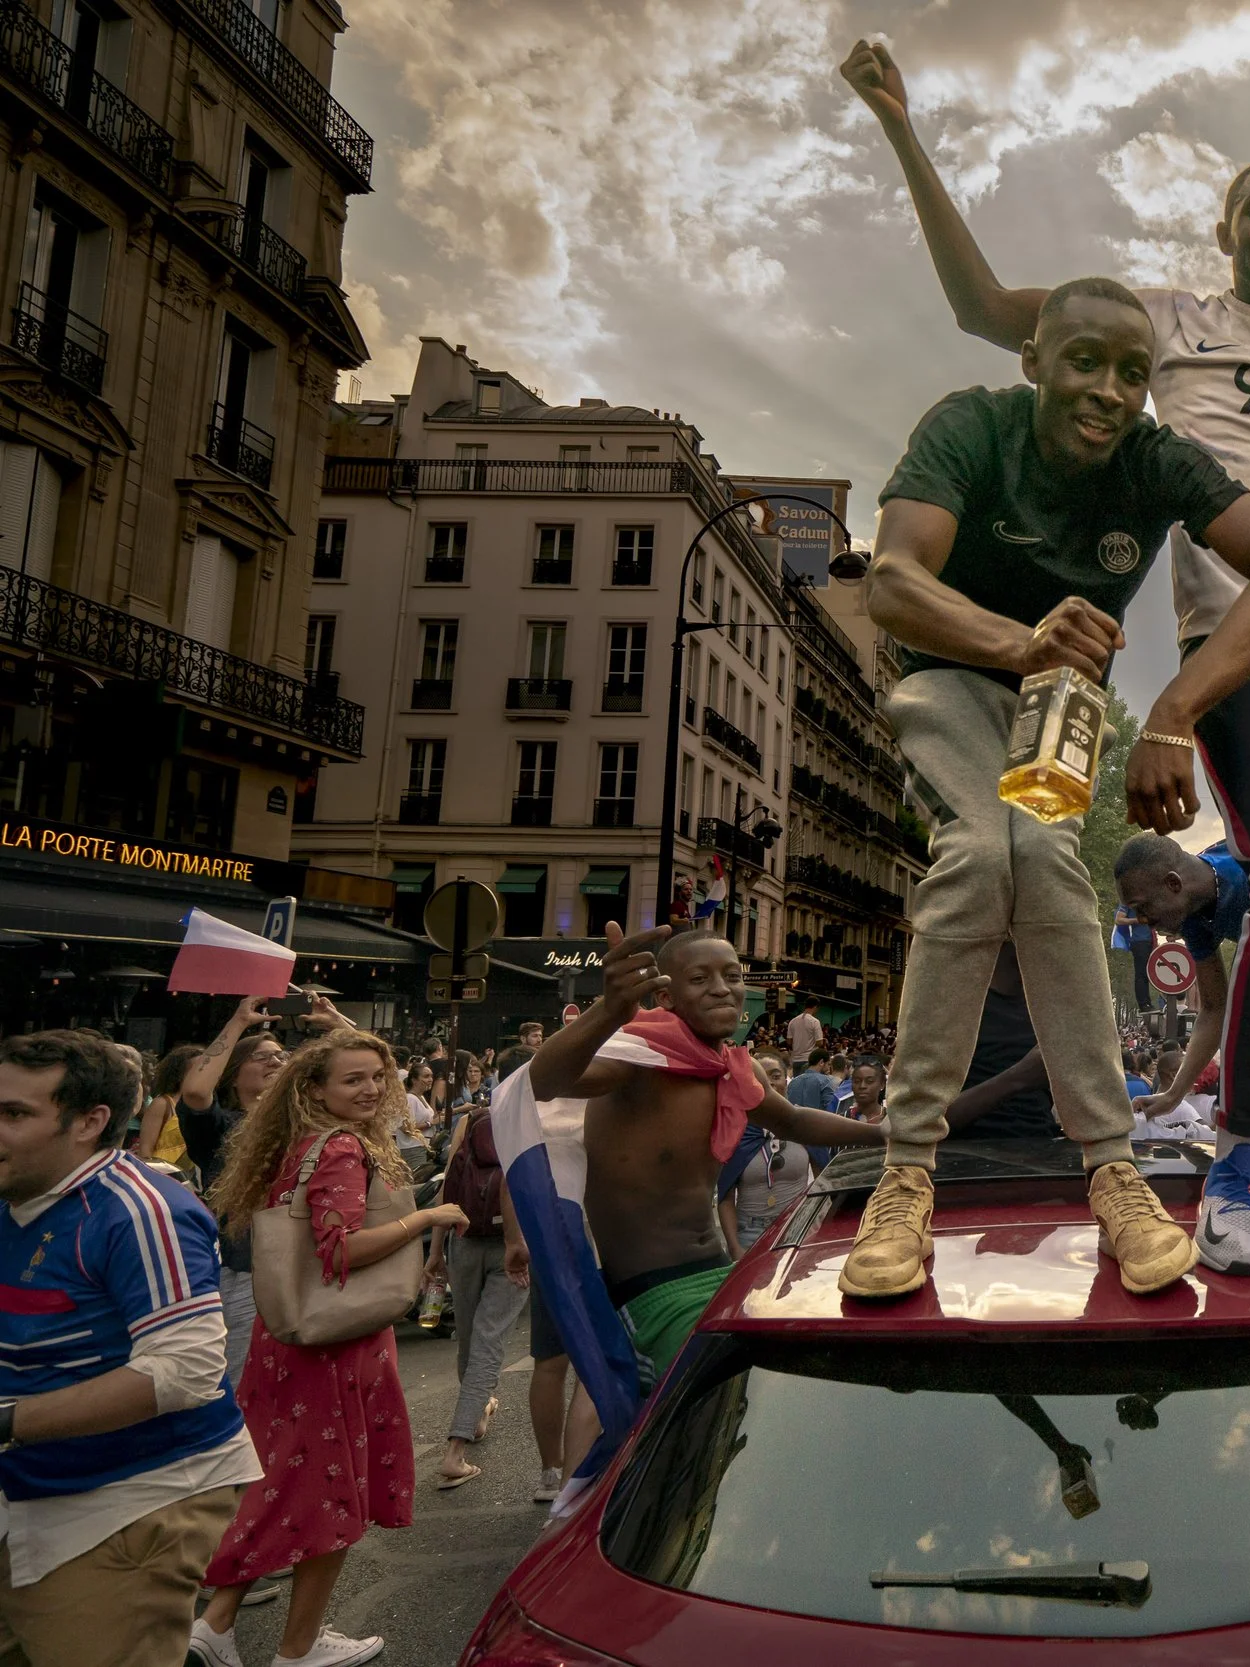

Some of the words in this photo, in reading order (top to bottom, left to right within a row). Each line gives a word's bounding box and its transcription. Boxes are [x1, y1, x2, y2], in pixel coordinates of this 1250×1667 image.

[778, 505, 829, 520] Savon
[778, 525, 829, 540] Cadum
[1103, 534, 1129, 546] PARIS
[1, 823, 33, 849] LA
[40, 830, 116, 862] PORTE
[120, 843, 255, 882] MONTMARTRE
[268, 911, 284, 940] P
[544, 951, 583, 967] Irish
[585, 951, 603, 967] Pu
